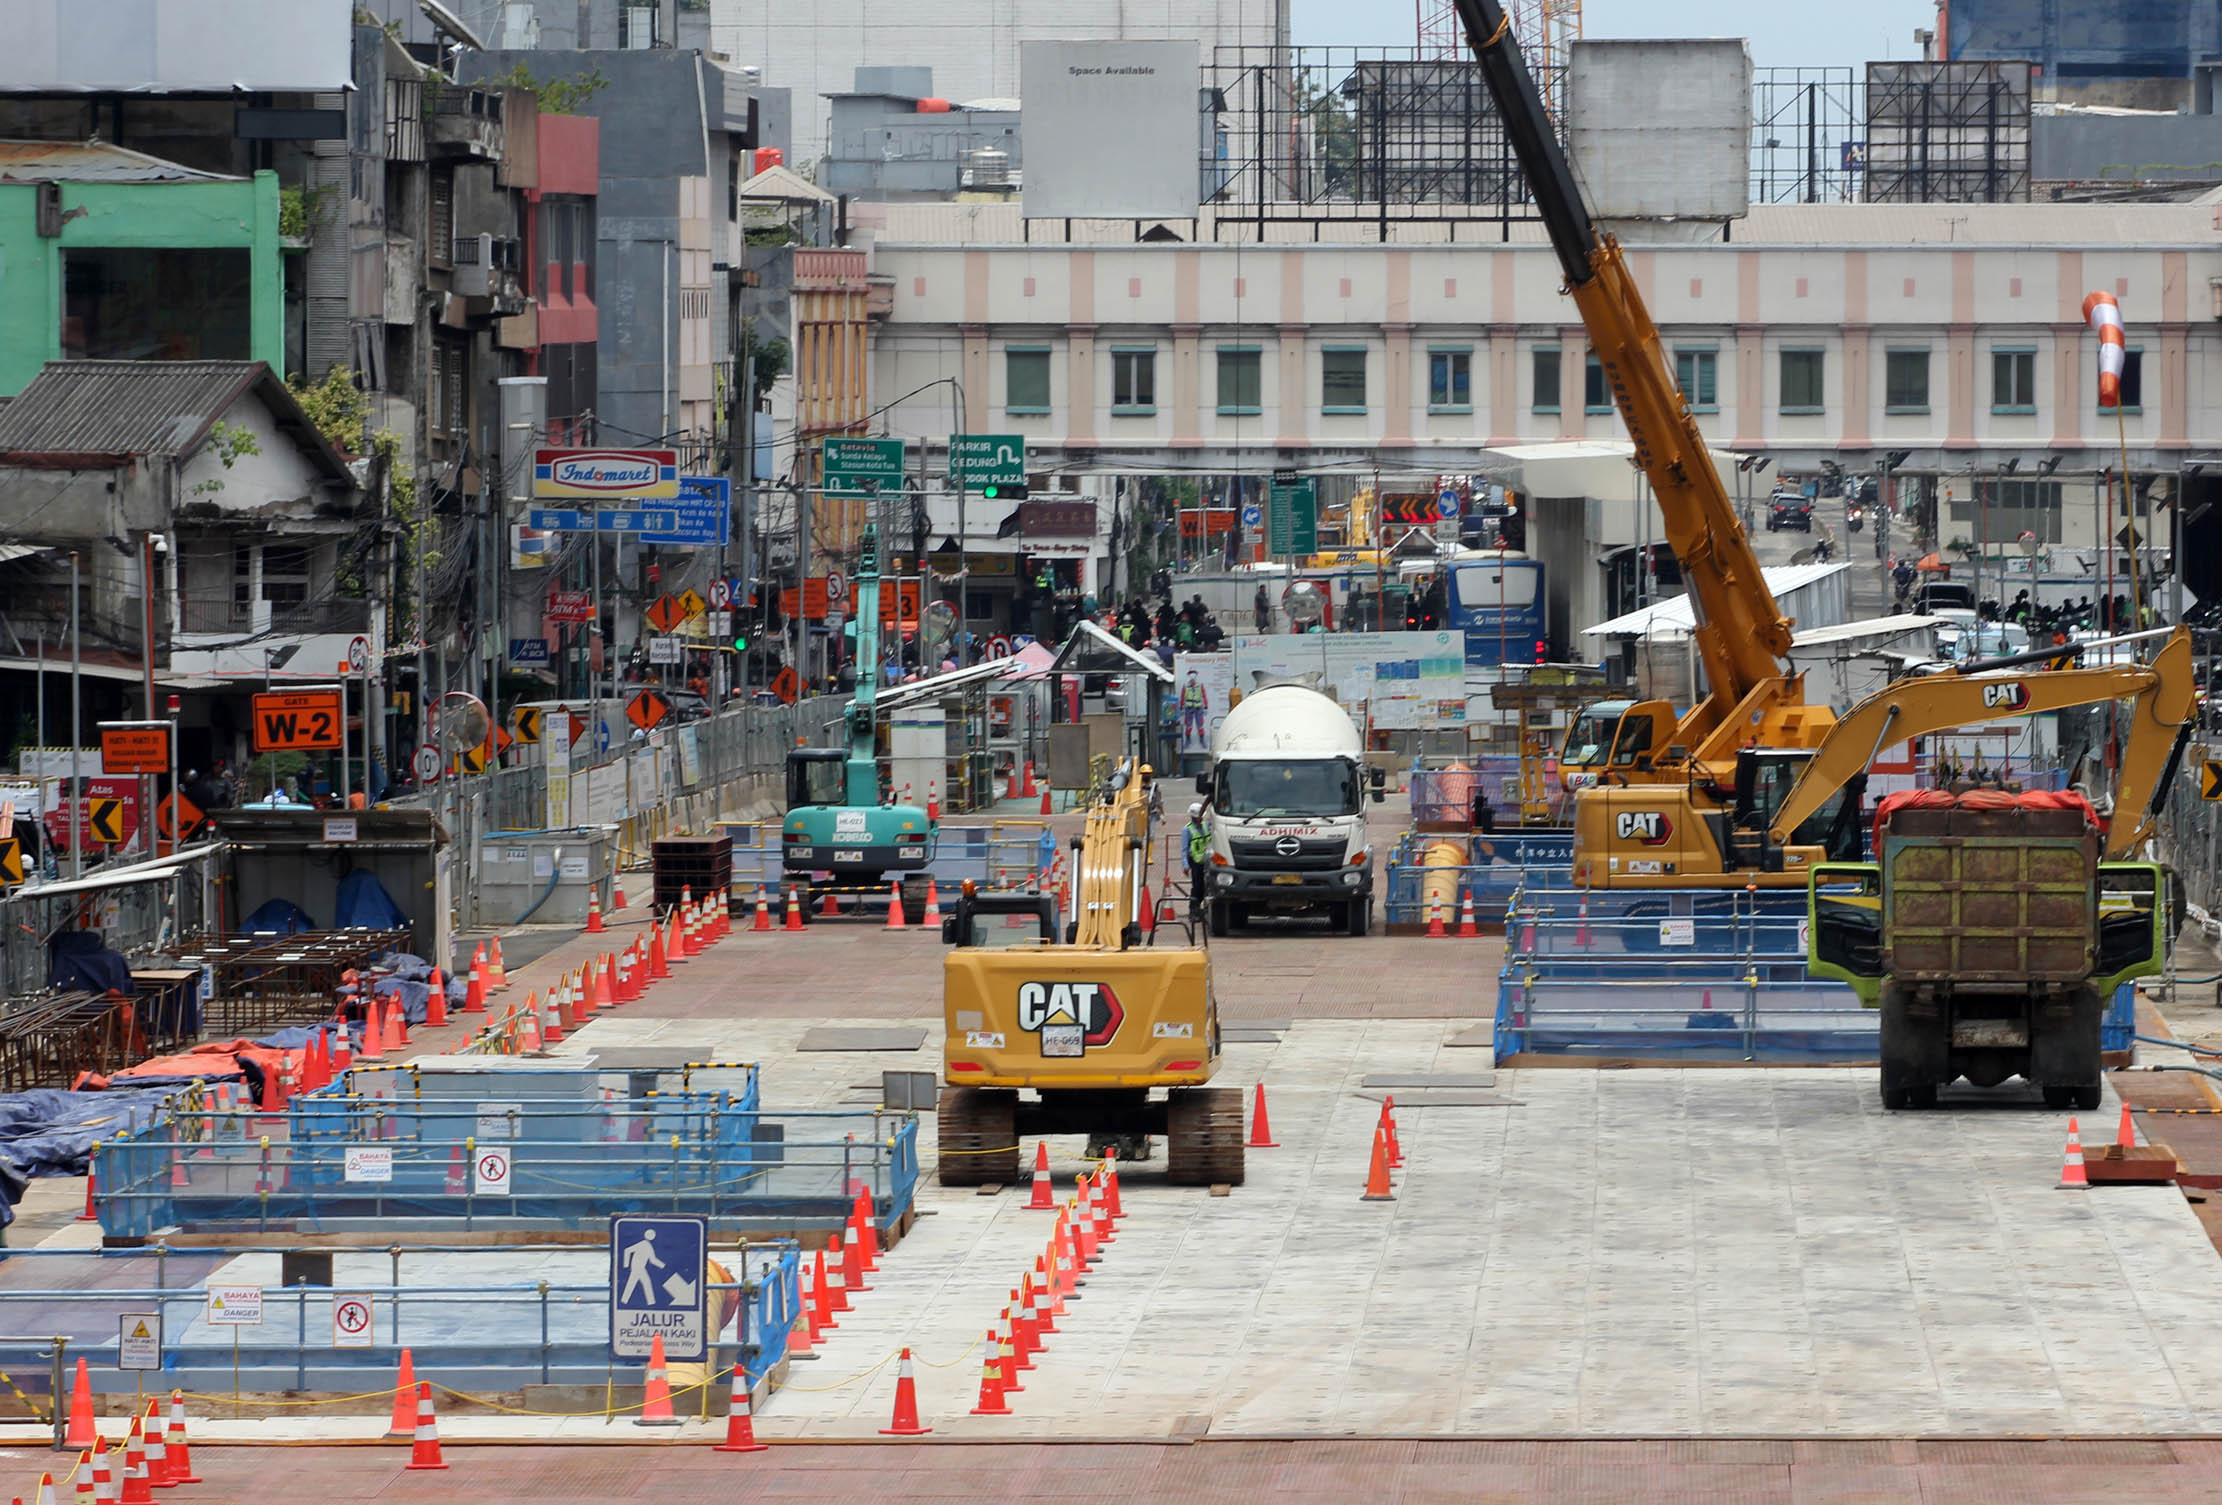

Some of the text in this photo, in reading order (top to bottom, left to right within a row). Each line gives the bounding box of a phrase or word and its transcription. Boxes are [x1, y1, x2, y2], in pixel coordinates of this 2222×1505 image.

[1069, 66, 1155, 76] Space Available
[951, 442, 991, 452] PARKIR
[883, 462, 896, 470] Tua
[559, 464, 651, 482] Indomaret
[990, 474, 1025, 483] PLAZA
[1984, 682, 2018, 708] CAT
[264, 712, 331, 743] W-2
[1617, 812, 1660, 839] CAT
[1259, 827, 1318, 836] ADHIMIX
[832, 833, 873, 842] KOBELCO
[1019, 983, 1098, 1031] CAT
[223, 1309, 259, 1317] DANGER
[631, 1313, 685, 1327] JALUR
[620, 1329, 696, 1338] PEJALAN KAKI
